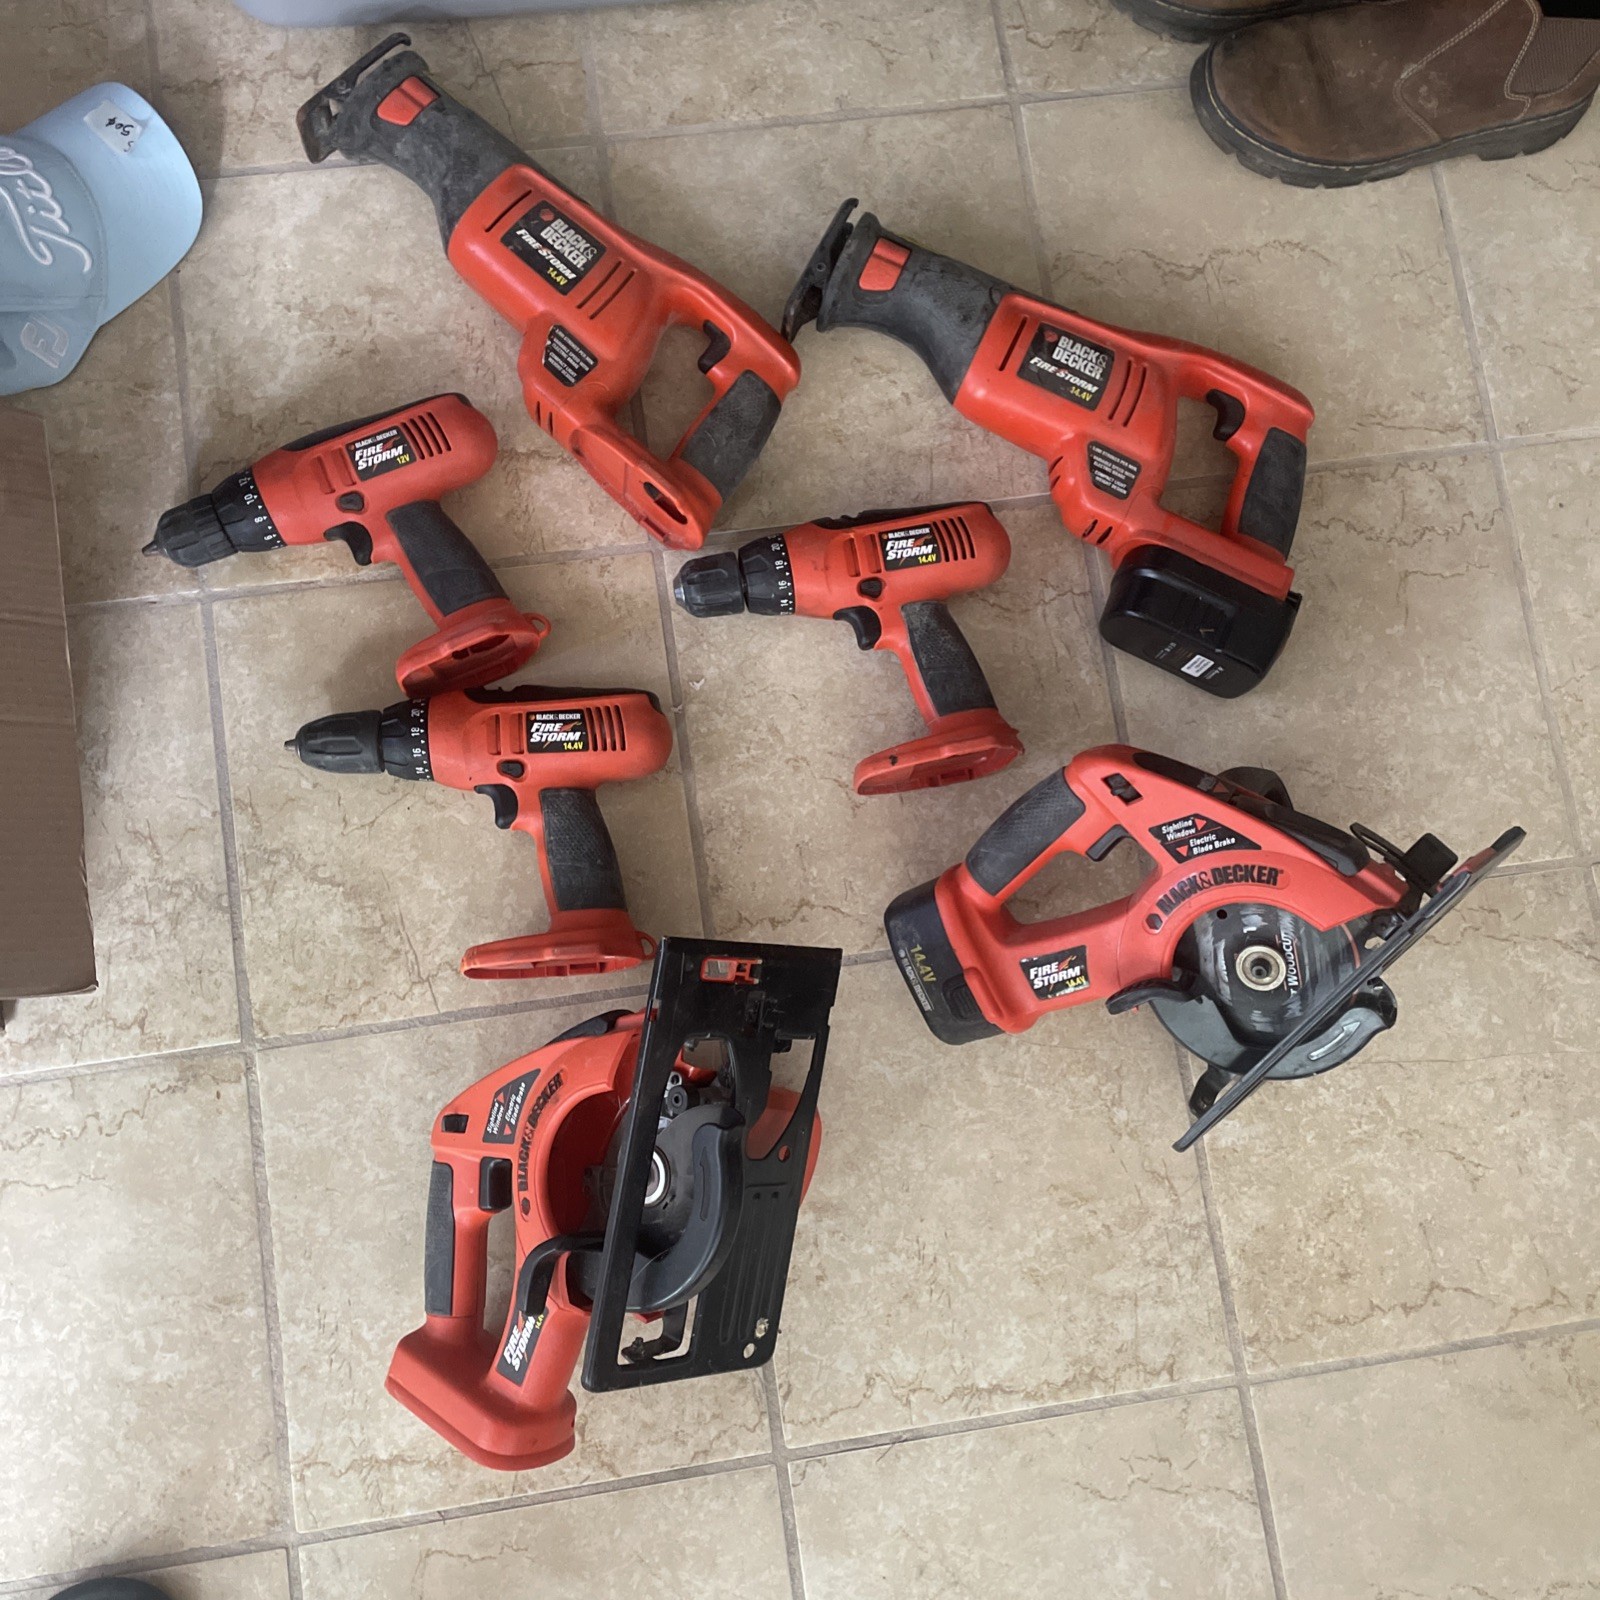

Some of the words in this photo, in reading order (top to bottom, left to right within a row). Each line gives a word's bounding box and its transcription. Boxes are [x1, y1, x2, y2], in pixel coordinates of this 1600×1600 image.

[540, 226, 588, 269] DECKER
[546, 266, 568, 286] 14.4V
[1052, 346, 1104, 380] DECKER
[1069, 386, 1093, 402] 14.4V
[355, 443, 384, 461] FIRE
[357, 445, 403, 471] STORM
[396, 453, 410, 465] 12V
[243, 493, 255, 506] 10
[886, 538, 915, 551] FIRE
[886, 544, 933, 560] STORM
[774, 560, 785, 570] 18
[918, 553, 937, 564] 14.4V
[778, 580, 788, 590] 16
[410, 726, 420, 737] 18
[530, 722, 564, 733] FIRE
[530, 731, 582, 743] STORM
[412, 747, 422, 757] 16
[563, 741, 583, 750] 14.4V
[1161, 819, 1193, 835] Sightline
[1166, 827, 1196, 842] Window
[1189, 833, 1217, 847] Electric
[1192, 844, 1213, 855] Blade
[1214, 837, 1236, 849] Brake
[910, 943, 937, 982] 14.4V
[1029, 961, 1059, 980] FIRE
[1033, 965, 1081, 990] STORM
[1065, 975, 1086, 988] 14.4V
[504, 1093, 517, 1122] Electric
[510, 1104, 522, 1126] Blade
[516, 1082, 526, 1106] Brake
[486, 1101, 499, 1134] Sightline
[493, 1105, 504, 1135] Window
[503, 1324, 520, 1365] FIRE
[511, 1316, 536, 1372] STORM
